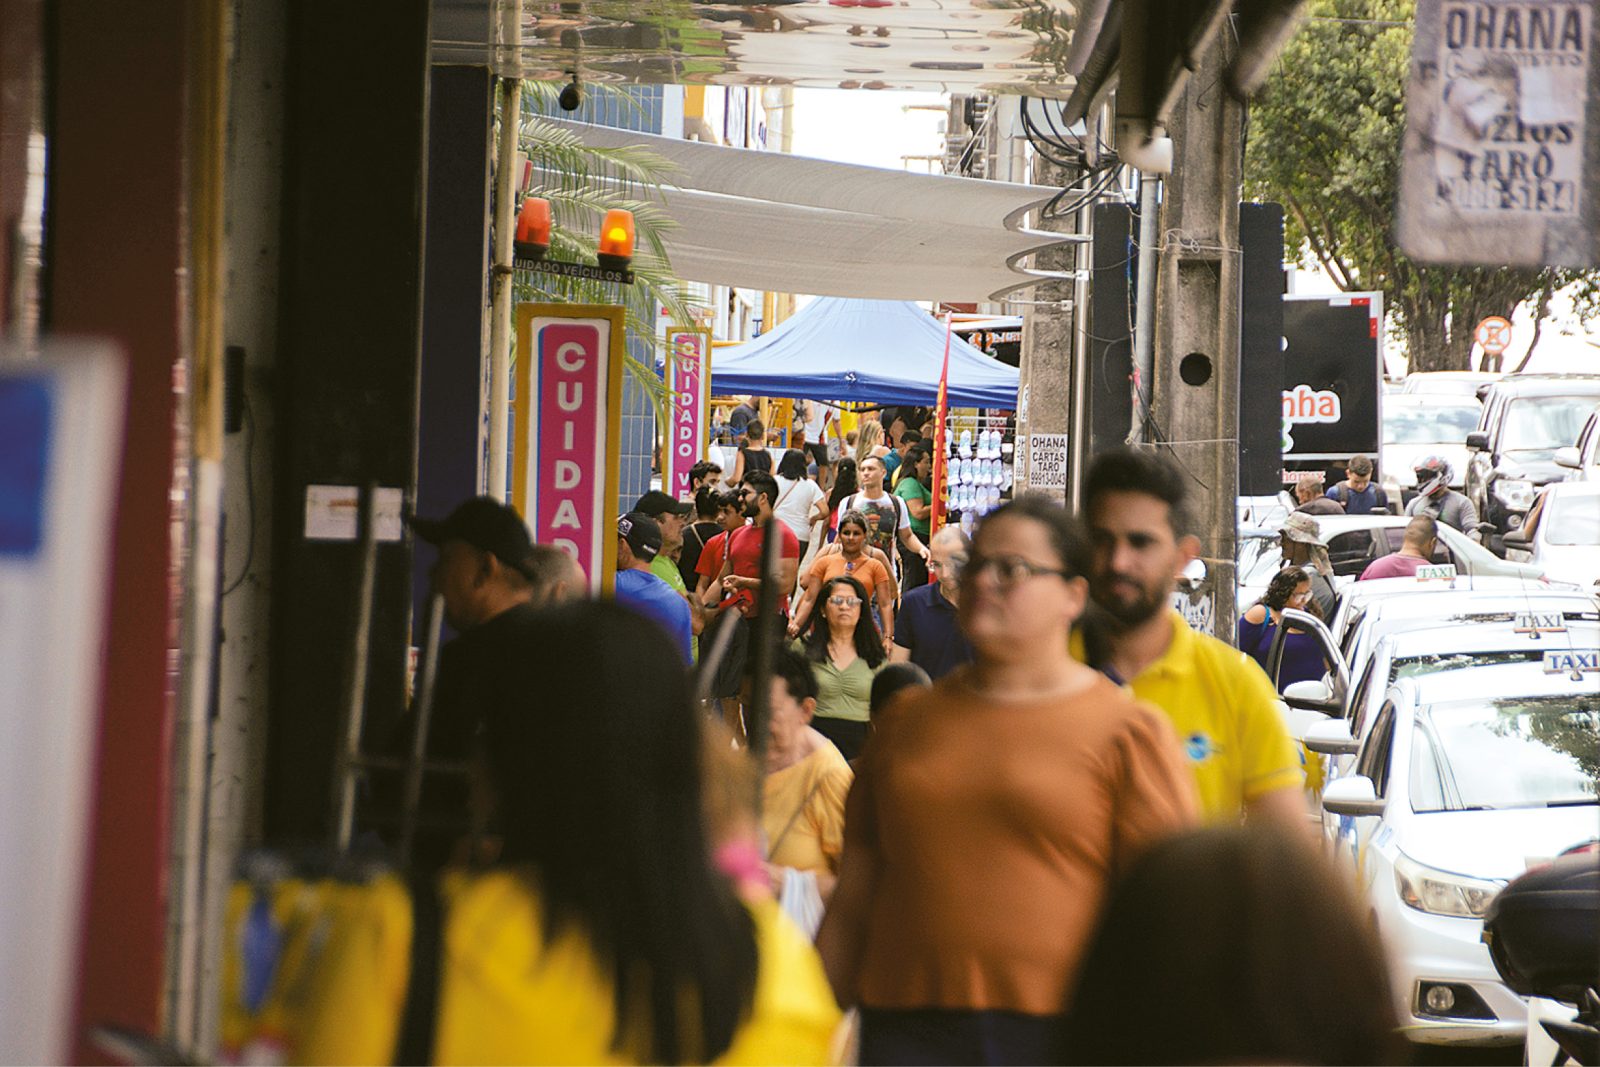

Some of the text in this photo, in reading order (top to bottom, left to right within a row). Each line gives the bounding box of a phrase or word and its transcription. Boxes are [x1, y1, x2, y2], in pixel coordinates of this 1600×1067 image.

[1446, 6, 1583, 50] OHANA
[678, 341, 694, 457] CUIDADO
[1282, 389, 1335, 417] nha
[1031, 437, 1066, 448] OHANA
[1032, 452, 1065, 462] CARTAS
[1038, 462, 1060, 472] TARO
[1418, 566, 1454, 578] TAXI
[1518, 614, 1562, 628] TAXI
[1549, 653, 1600, 669] TAXI
